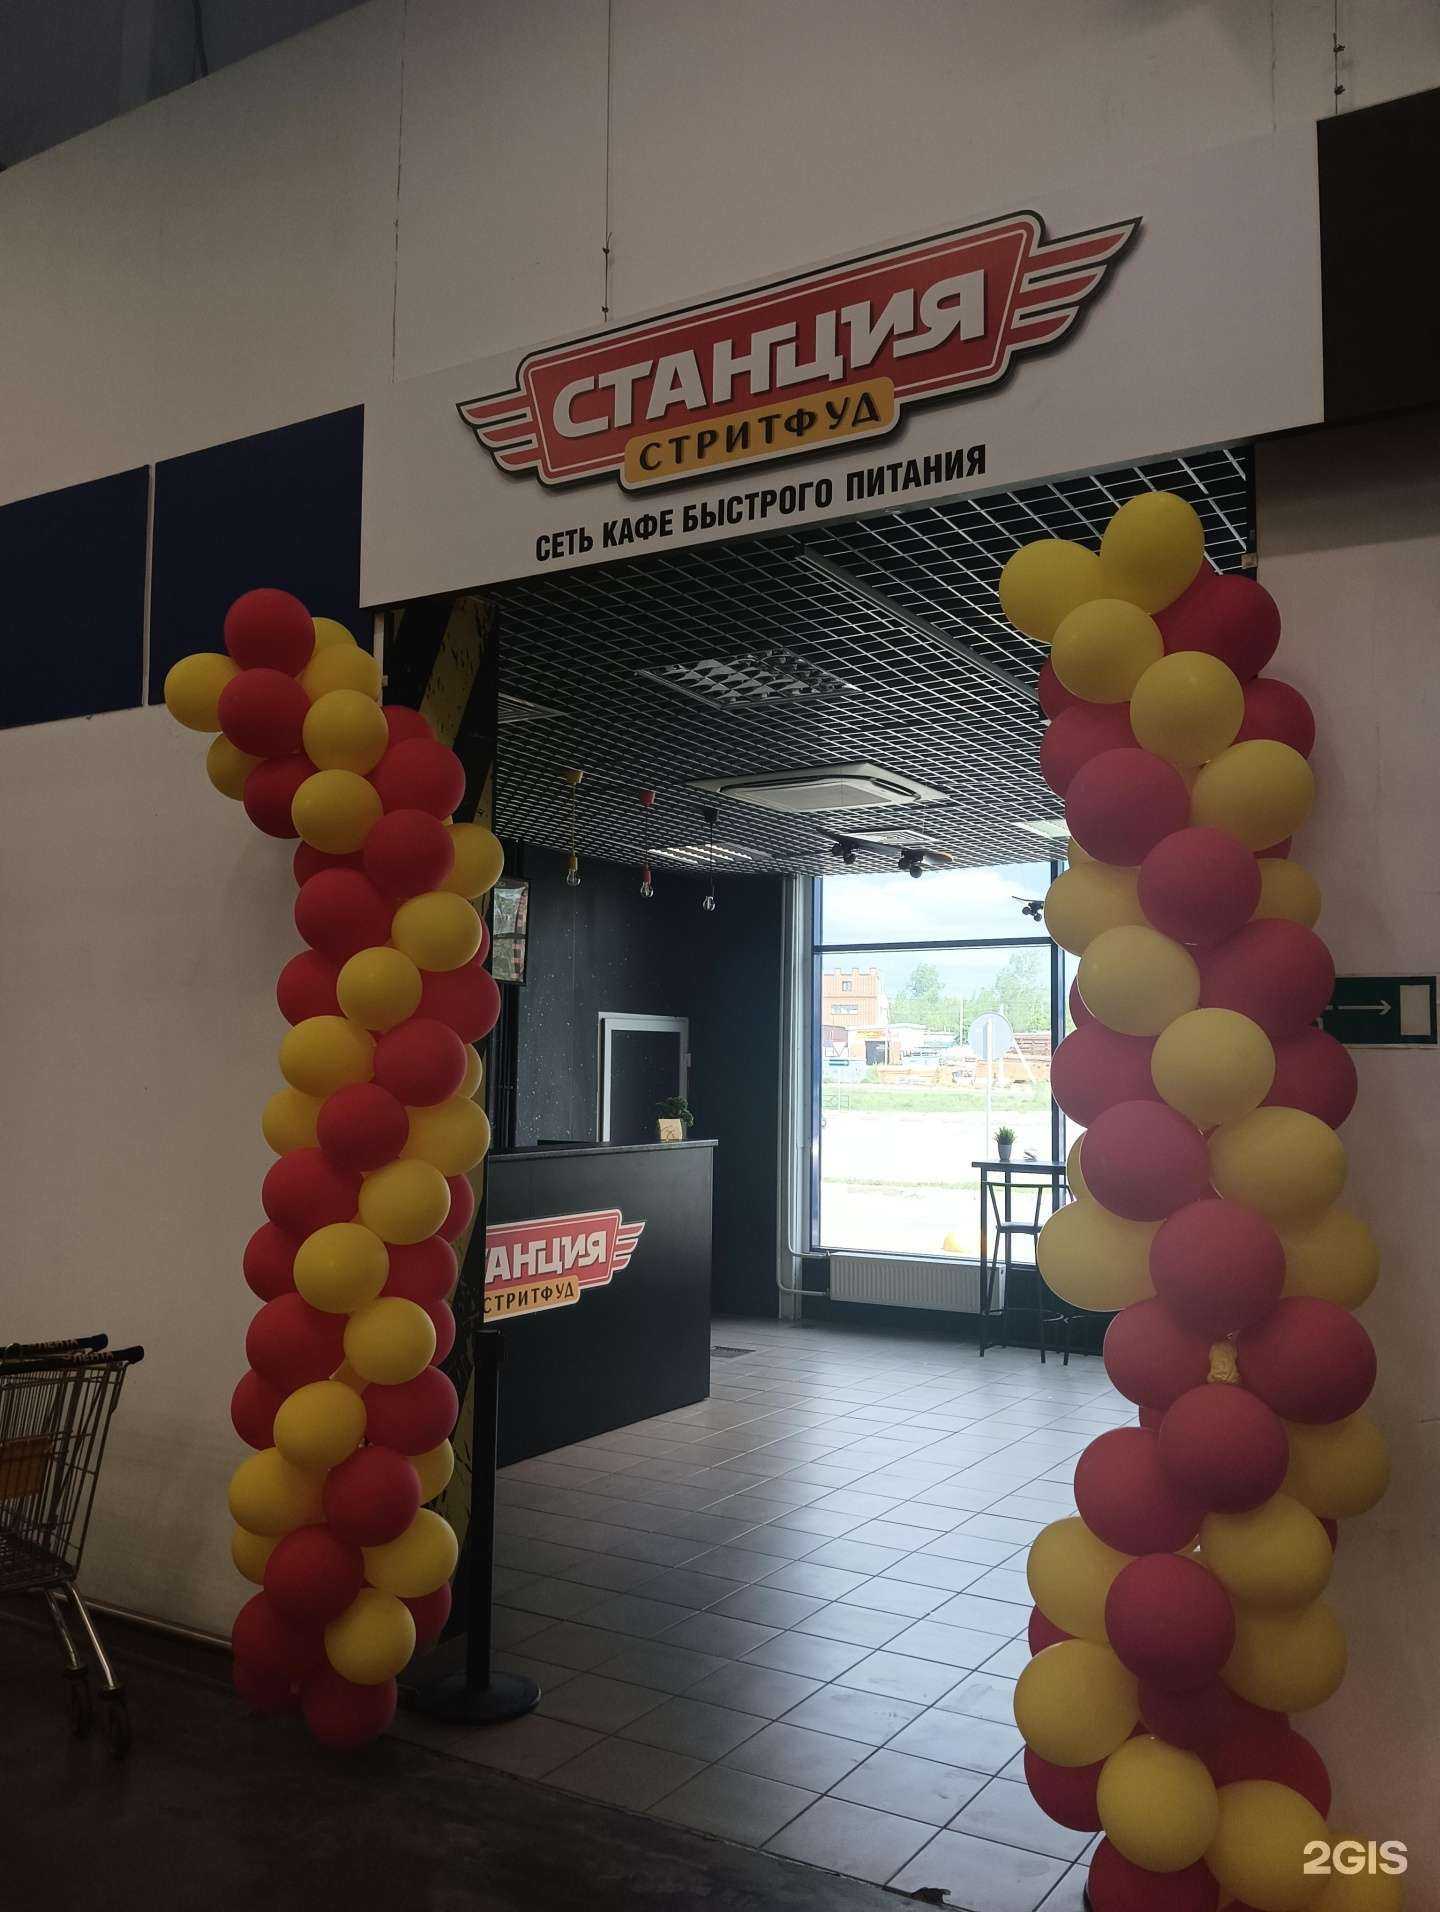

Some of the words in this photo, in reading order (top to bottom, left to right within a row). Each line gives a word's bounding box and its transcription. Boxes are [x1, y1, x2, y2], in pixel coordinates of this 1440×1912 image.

[552, 270, 986, 438] СТАНЦИЯ
[638, 391, 882, 471] СТРИТФУД
[535, 530, 594, 562] СЕТЬ
[602, 509, 674, 549] КАФЕ
[682, 478, 833, 533] БЫСТРОГО
[846, 443, 987, 502] ПИТАНИЯ
[485, 1231, 607, 1283] АНЦИЯ
